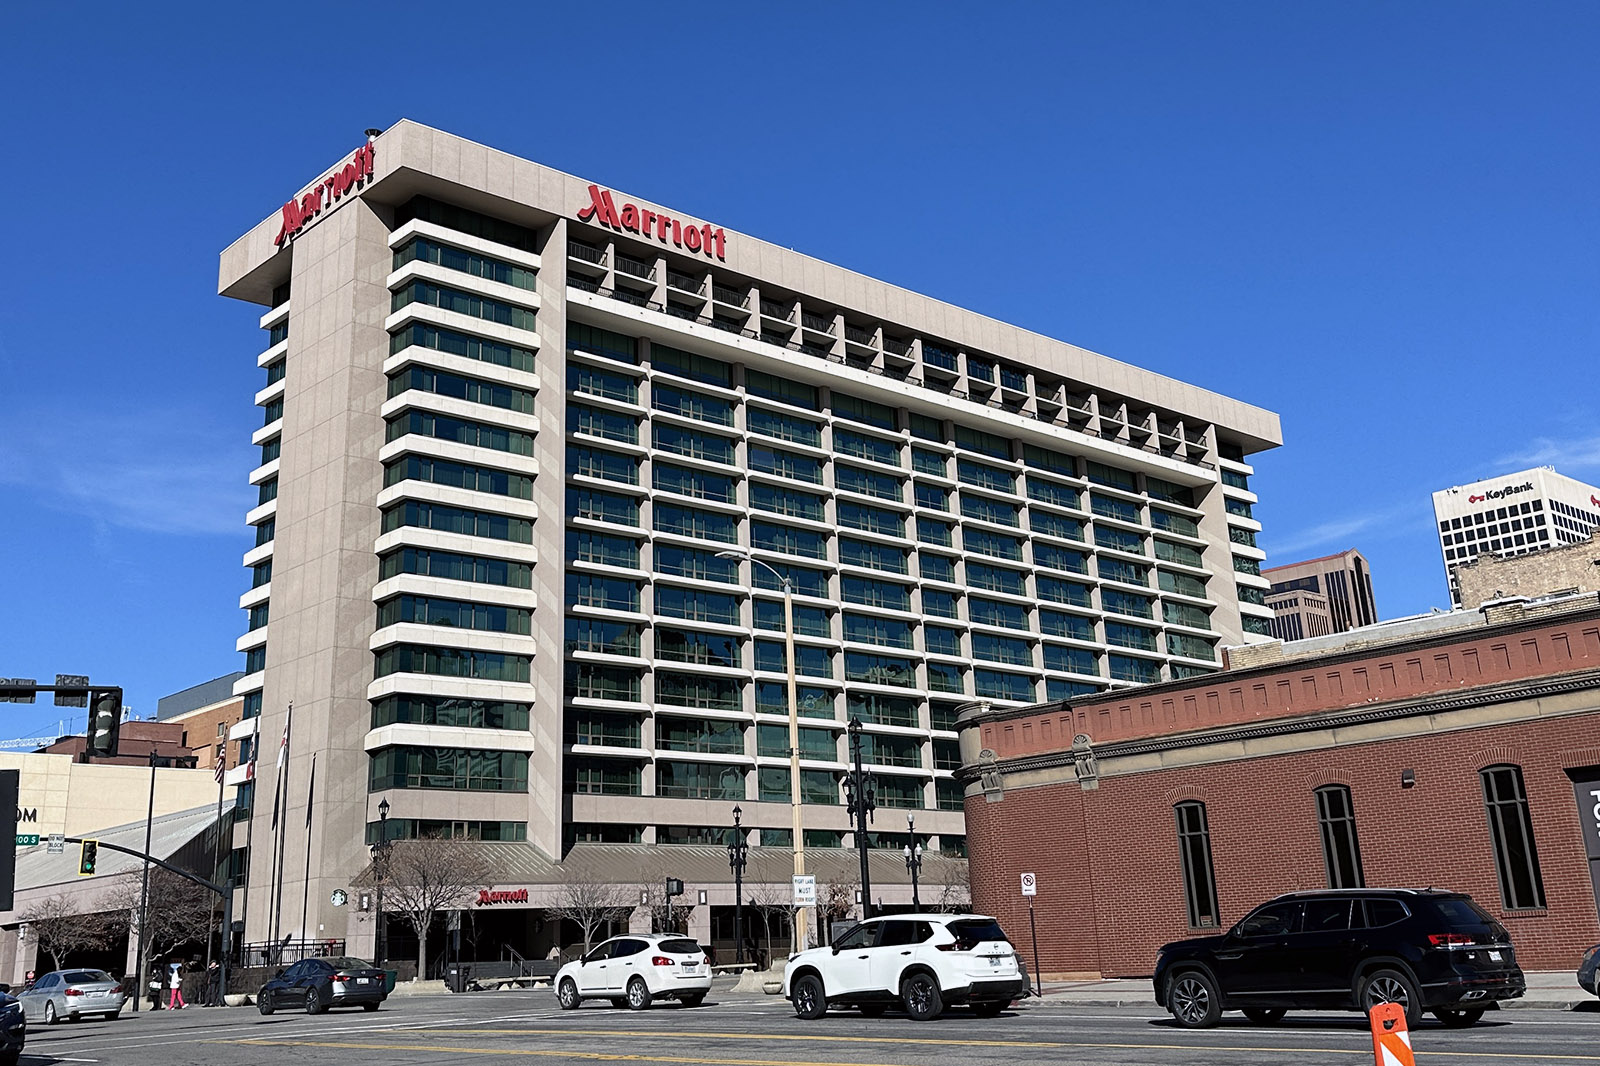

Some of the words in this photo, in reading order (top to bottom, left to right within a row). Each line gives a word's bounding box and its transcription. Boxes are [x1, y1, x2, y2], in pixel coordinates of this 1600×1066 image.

[275, 141, 374, 246] Marriott
[578, 185, 727, 262] Marriott
[1485, 482, 1534, 500] KeyBank
[31, 836, 36, 844] S
[477, 888, 528, 906] Marriott
